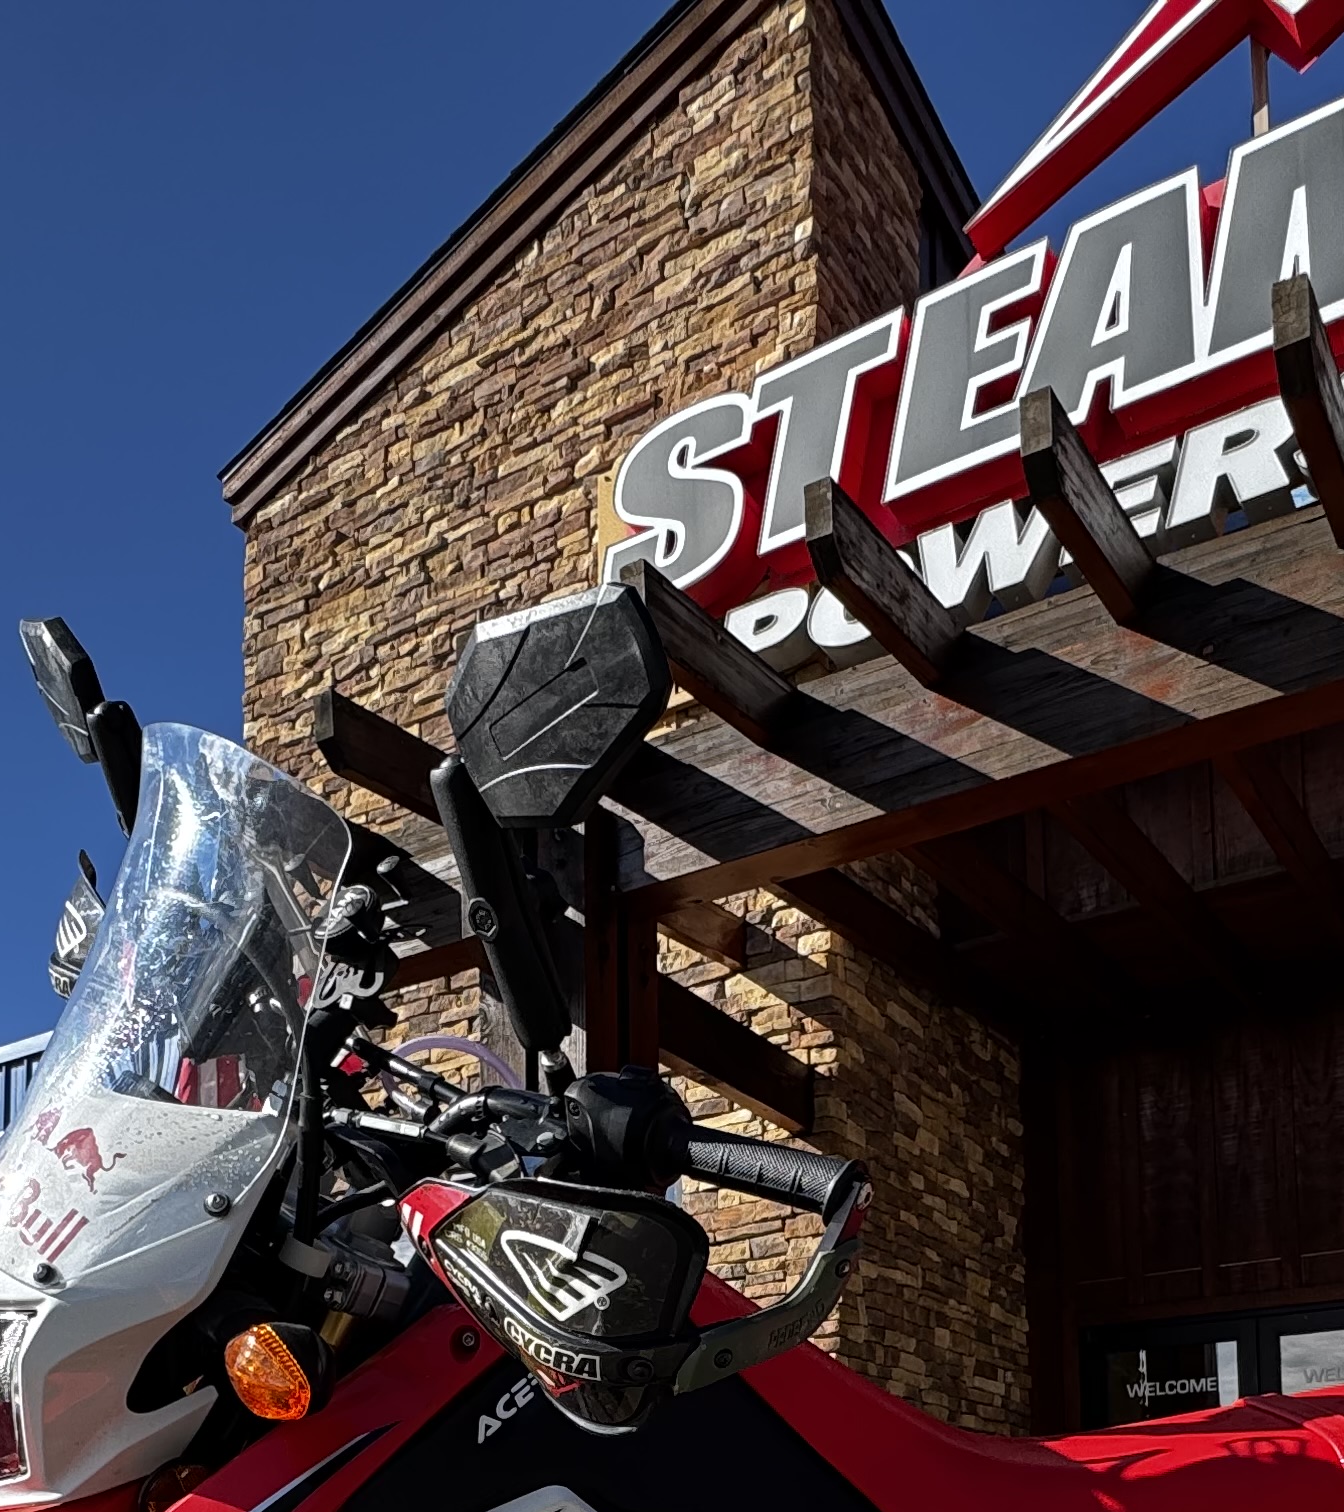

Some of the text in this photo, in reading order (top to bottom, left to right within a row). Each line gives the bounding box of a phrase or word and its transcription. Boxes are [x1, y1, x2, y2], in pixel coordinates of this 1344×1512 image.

[504, 1317, 602, 1381] CYCRA
[478, 1373, 538, 1445] ACE
[1126, 1376, 1218, 1399] WELCOME
